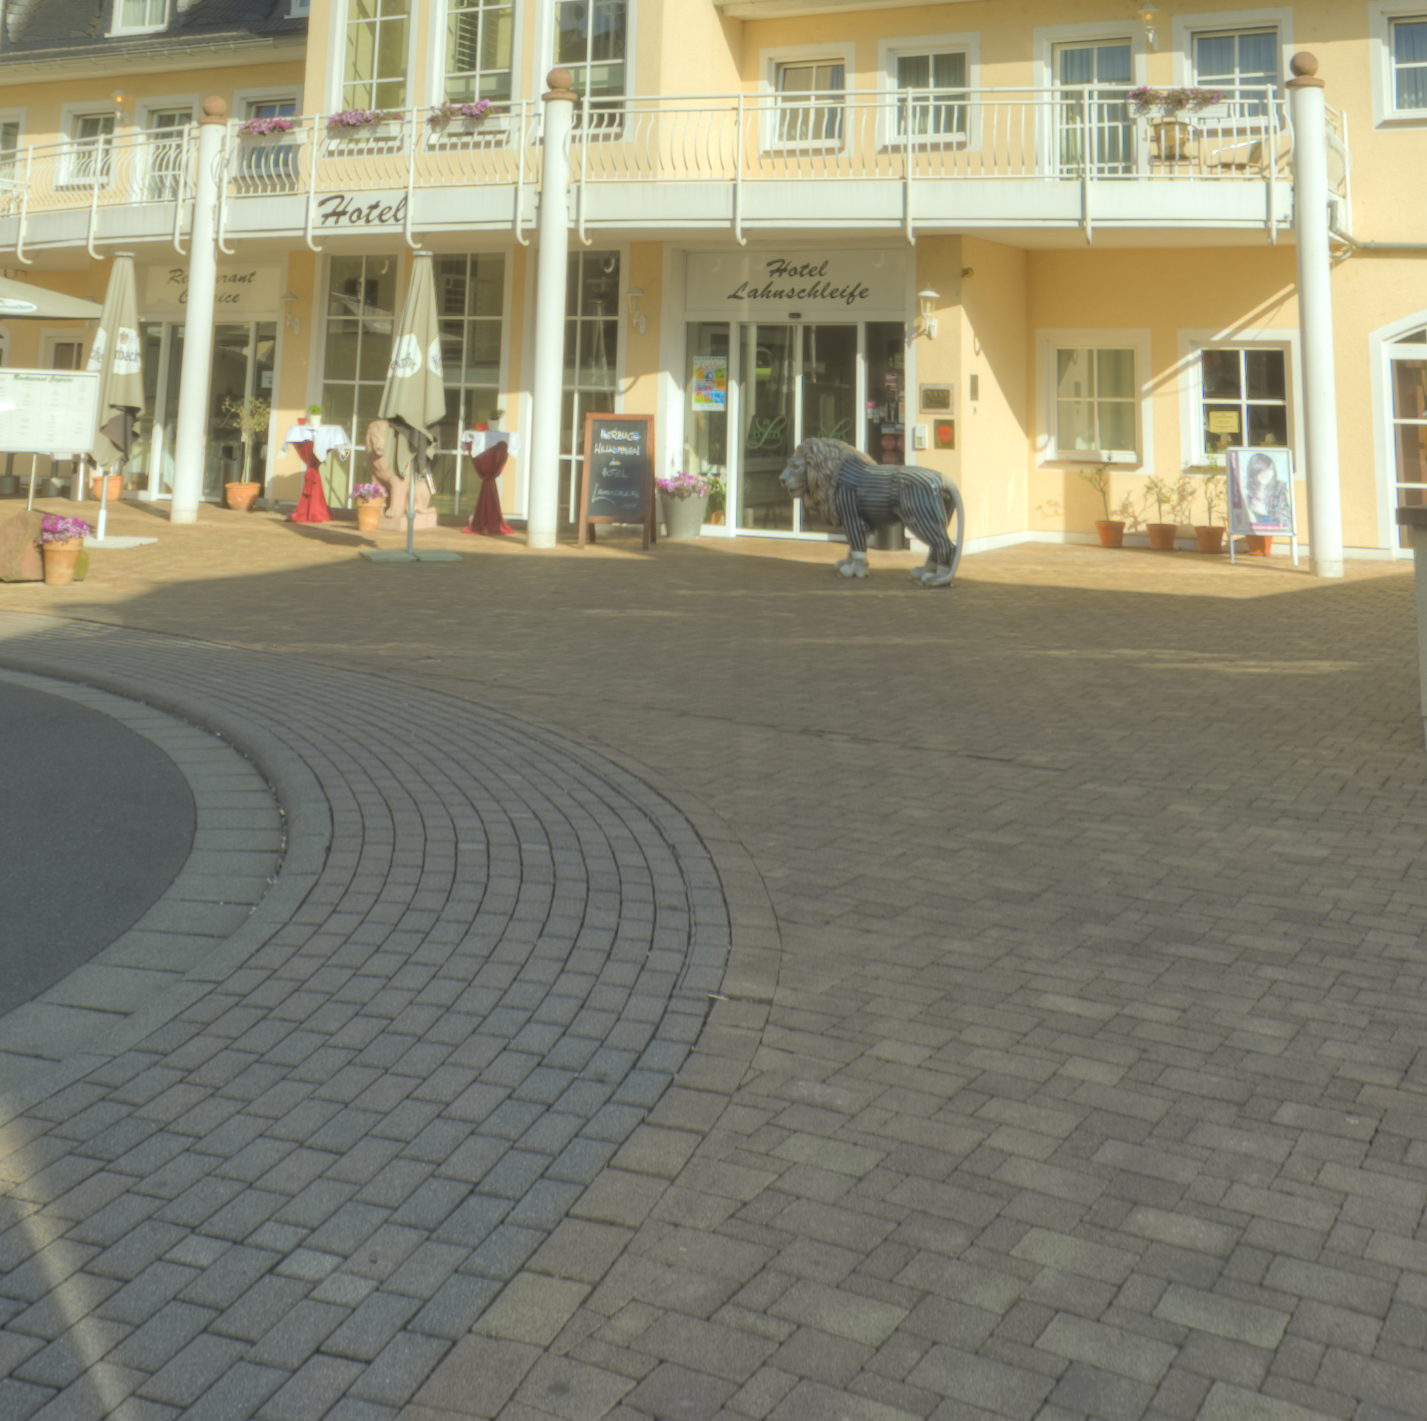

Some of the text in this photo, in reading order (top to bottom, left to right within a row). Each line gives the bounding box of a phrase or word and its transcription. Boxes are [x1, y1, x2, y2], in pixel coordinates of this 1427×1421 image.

[317, 194, 408, 225] Hotel
[766, 258, 829, 278] Hotel
[726, 280, 870, 305] Lahnschleife
